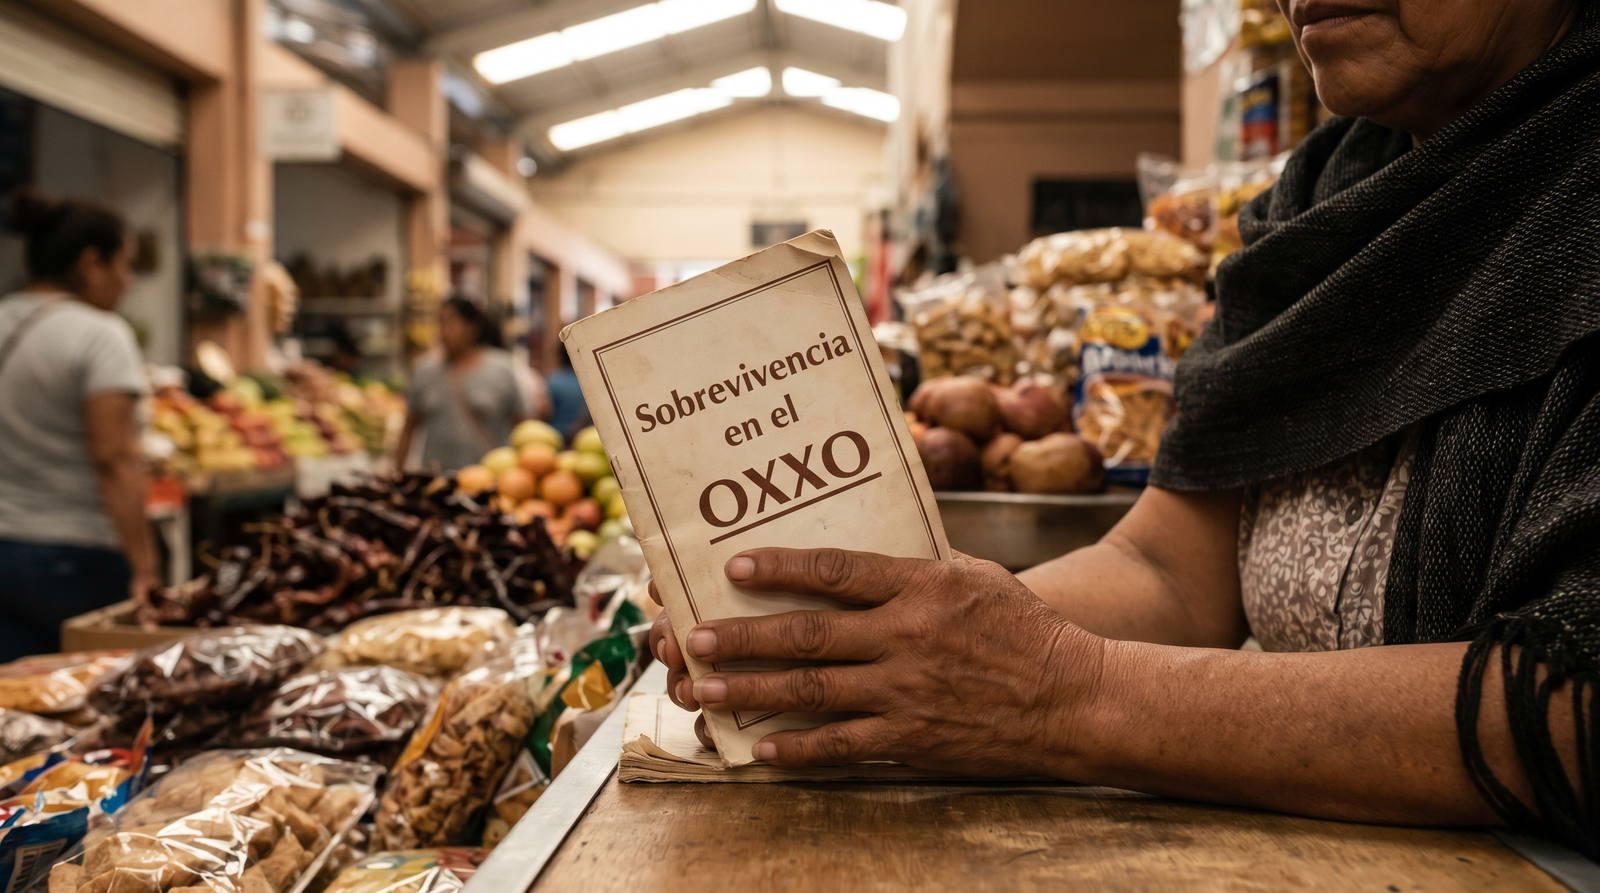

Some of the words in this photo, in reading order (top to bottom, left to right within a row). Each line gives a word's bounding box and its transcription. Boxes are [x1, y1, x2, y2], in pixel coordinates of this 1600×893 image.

[635, 331, 854, 433] Sobrevivencia
[724, 417, 764, 447] en
[770, 393, 800, 429] el
[698, 430, 871, 528] OXXO
